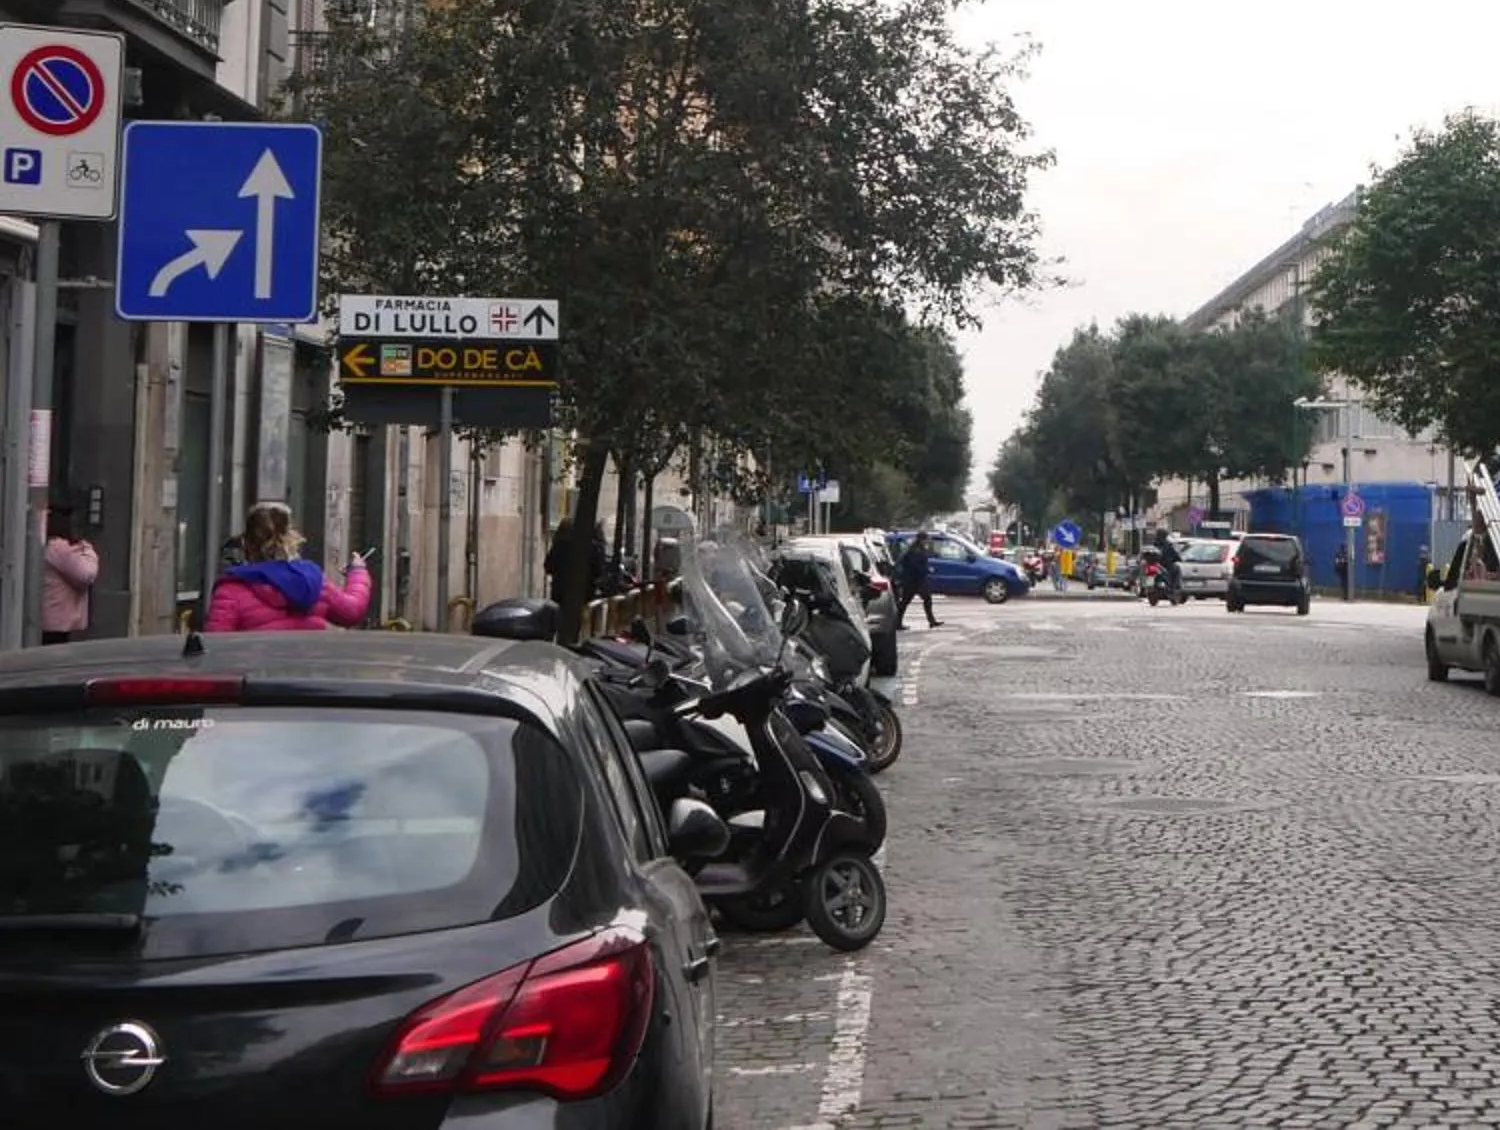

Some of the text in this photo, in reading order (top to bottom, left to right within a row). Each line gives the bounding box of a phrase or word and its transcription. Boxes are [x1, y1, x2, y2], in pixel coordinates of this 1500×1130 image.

[11, 151, 34, 180] P
[375, 299, 451, 312] FARMACIA
[354, 312, 478, 334] DI LULLO
[417, 345, 543, 371] DO DE CÀ
[131, 717, 150, 731] di
